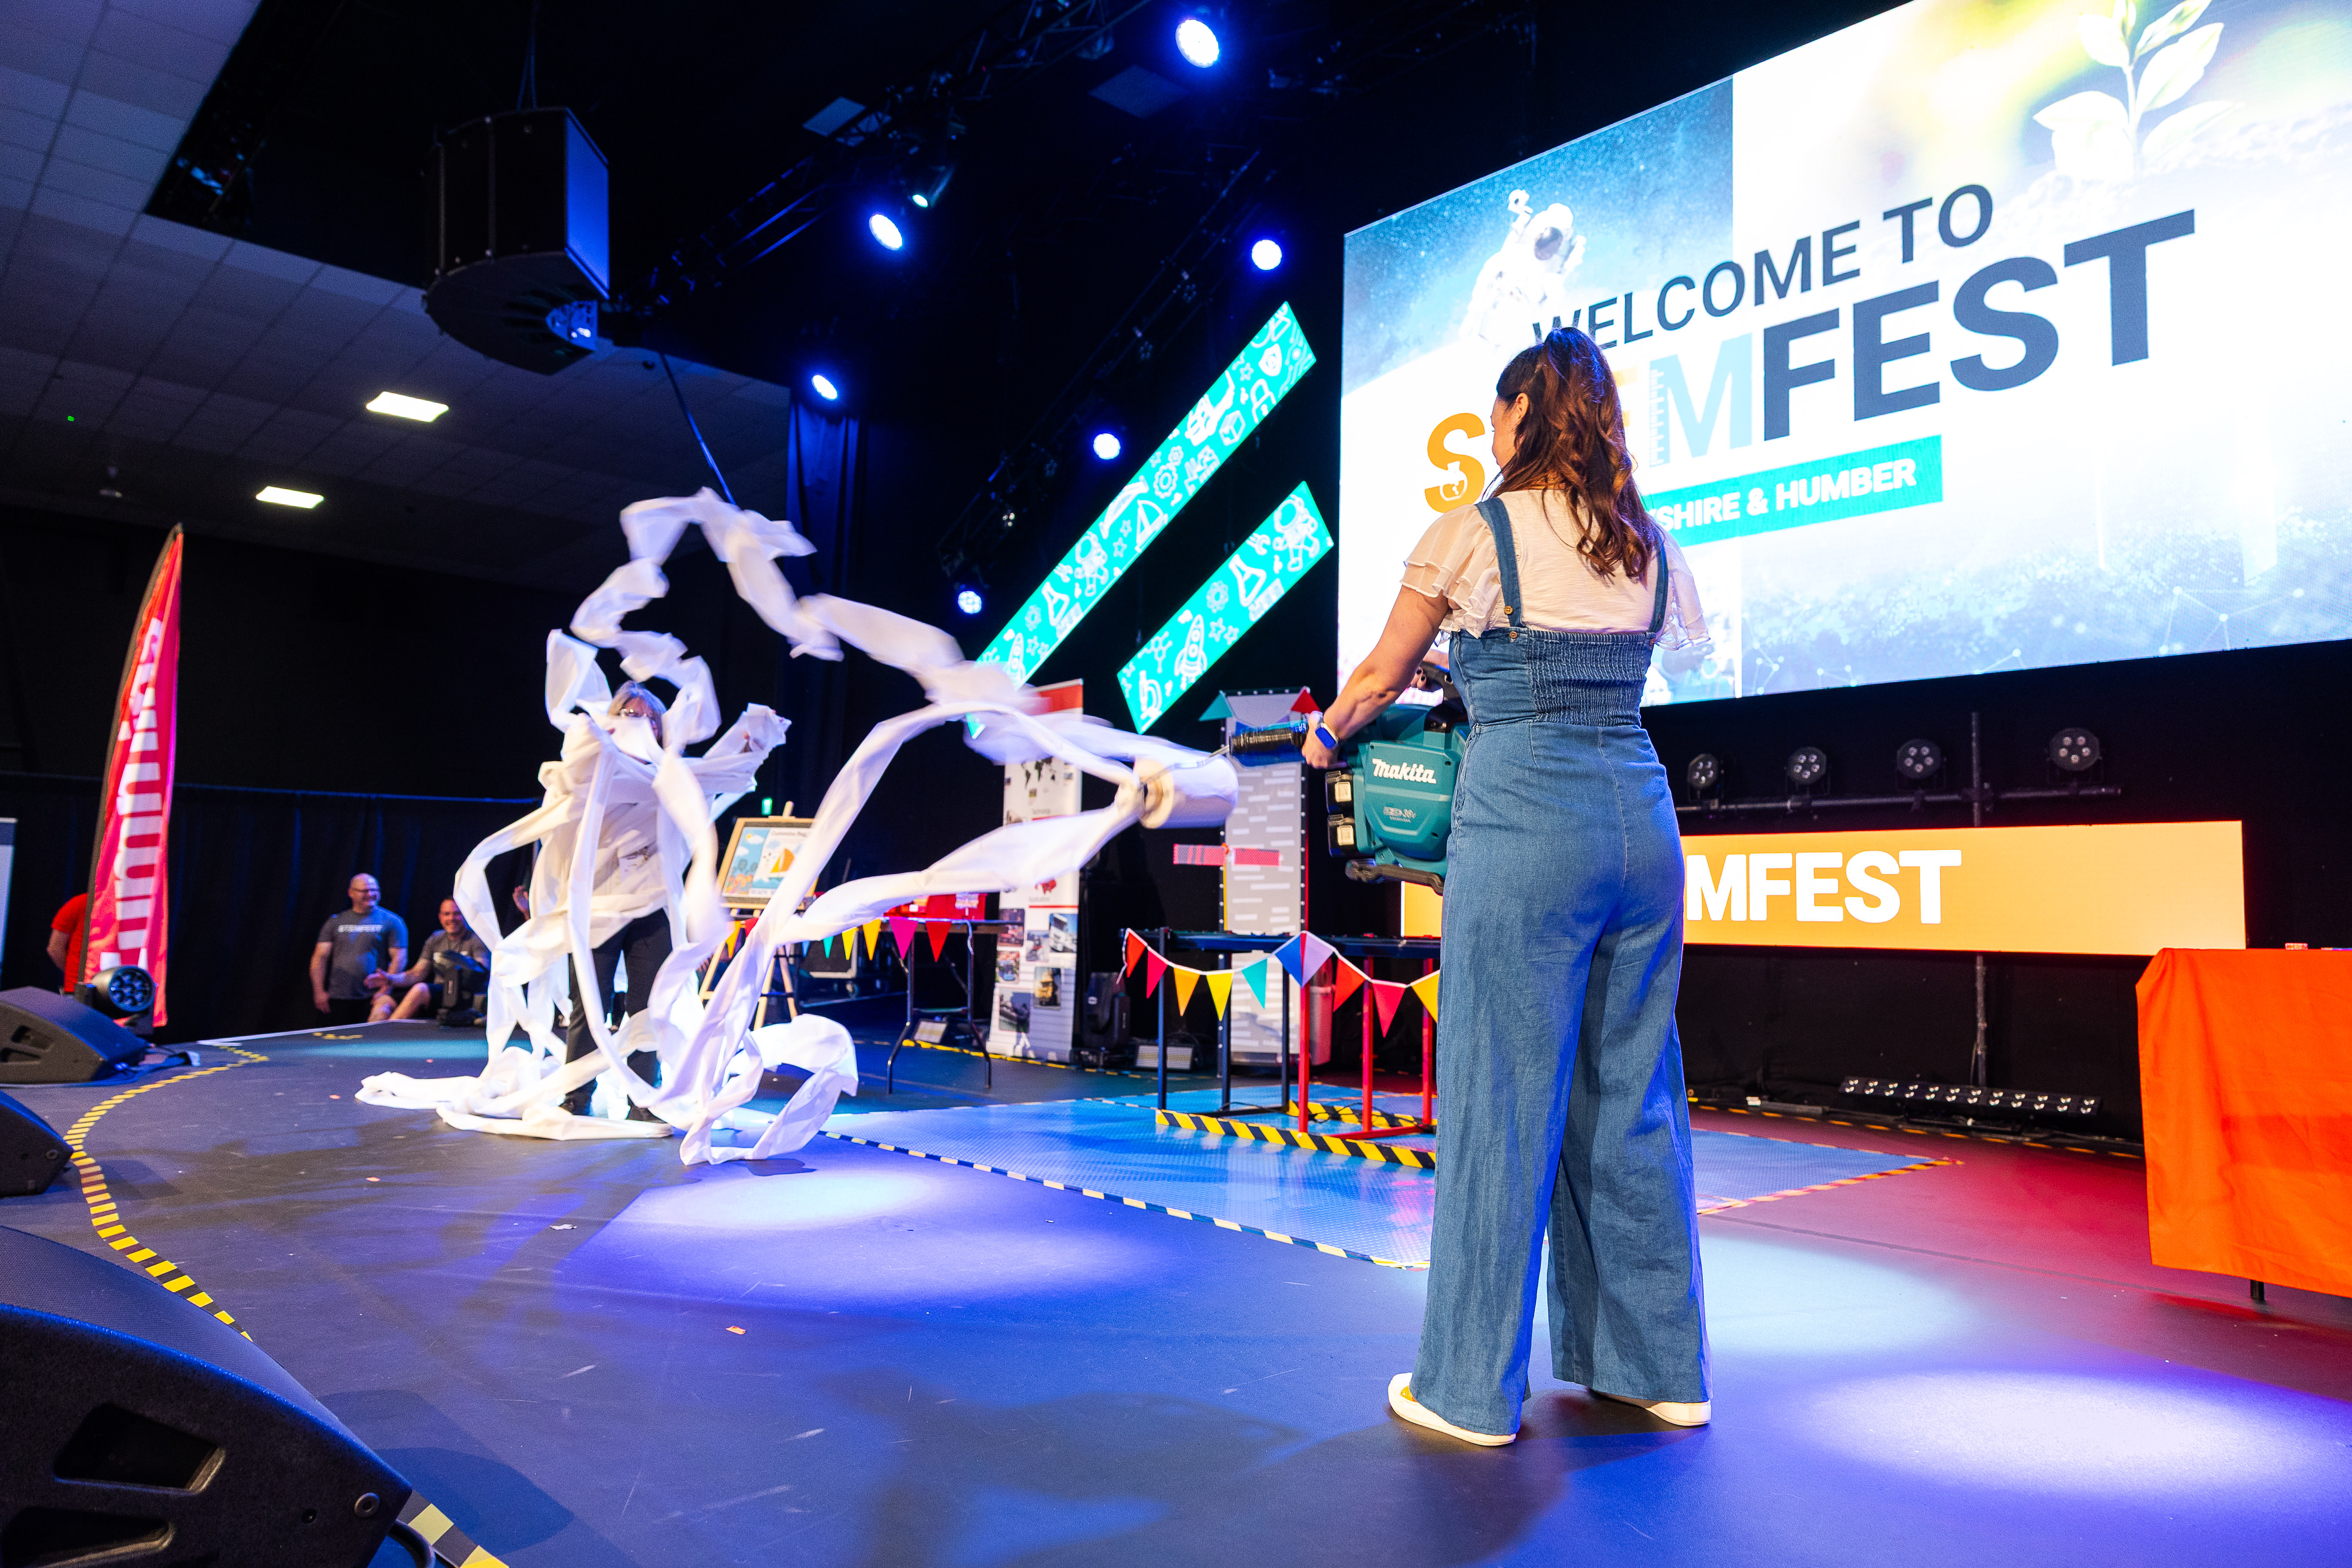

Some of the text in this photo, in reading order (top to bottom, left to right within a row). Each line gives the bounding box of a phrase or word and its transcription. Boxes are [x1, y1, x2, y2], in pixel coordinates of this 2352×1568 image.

[1883, 184, 1993, 263] TO
[1648, 458, 1917, 532] SHIRE & HUMBER
